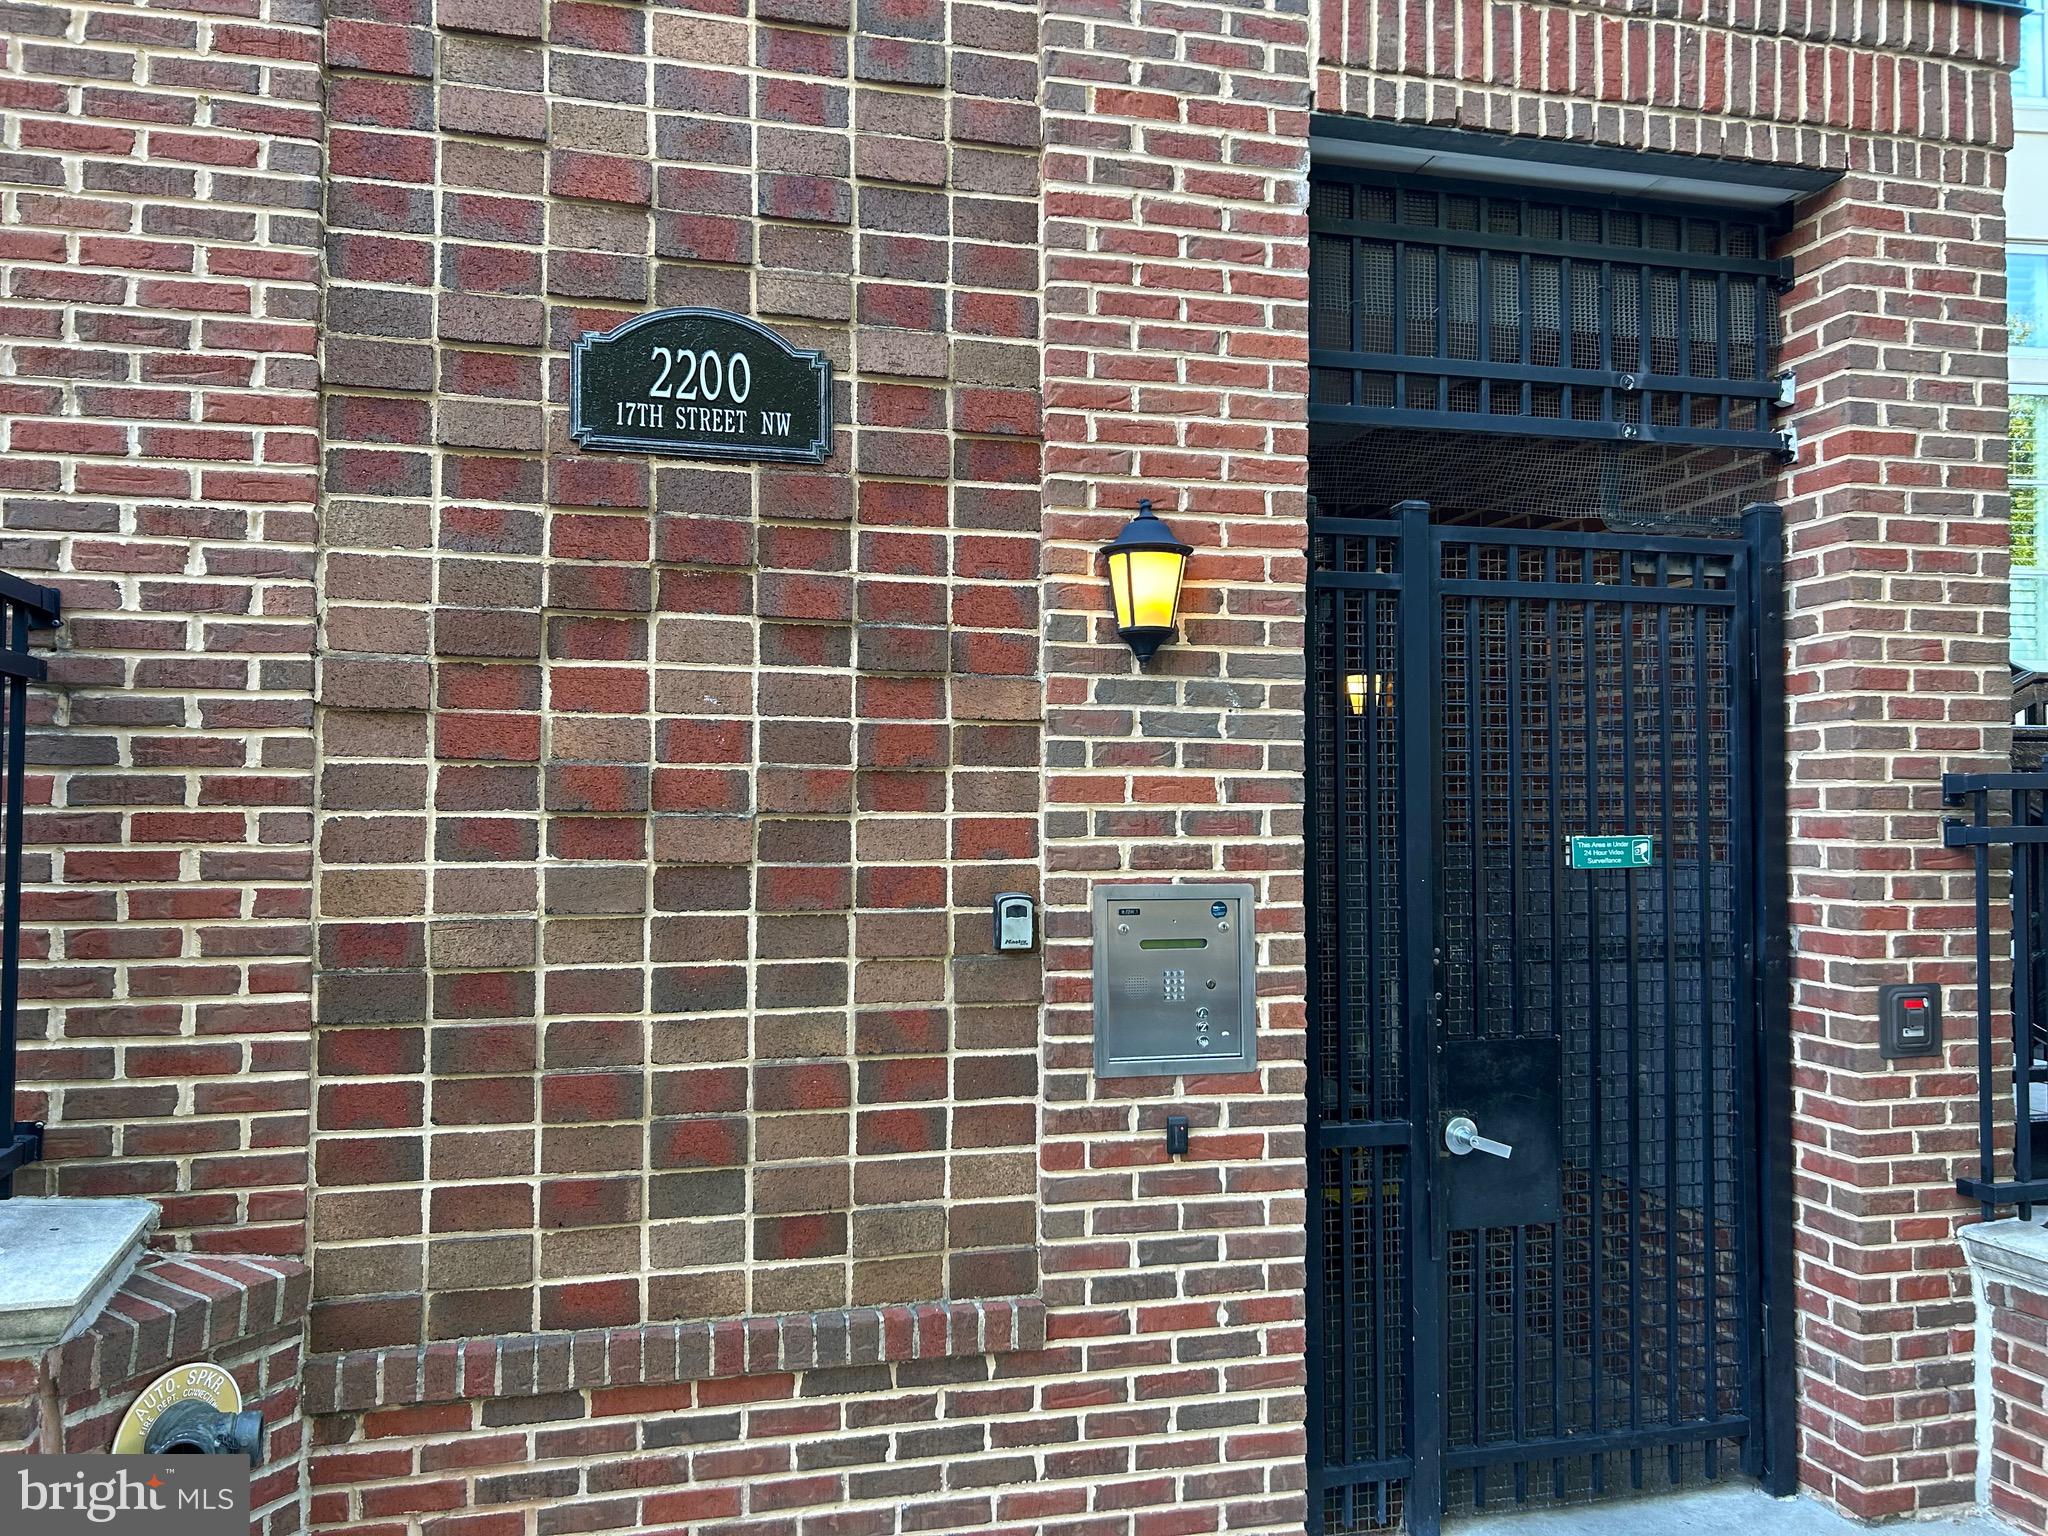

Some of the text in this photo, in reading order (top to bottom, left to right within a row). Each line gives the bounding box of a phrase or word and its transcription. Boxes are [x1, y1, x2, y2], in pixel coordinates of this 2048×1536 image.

[650, 347, 751, 404] 2200
[616, 402, 792, 437] 17TH STREET NW
[135, 1369, 225, 1422] AUTO. SPKR.
[139, 1388, 219, 1437] FIRE DEPT. CONNECTION
